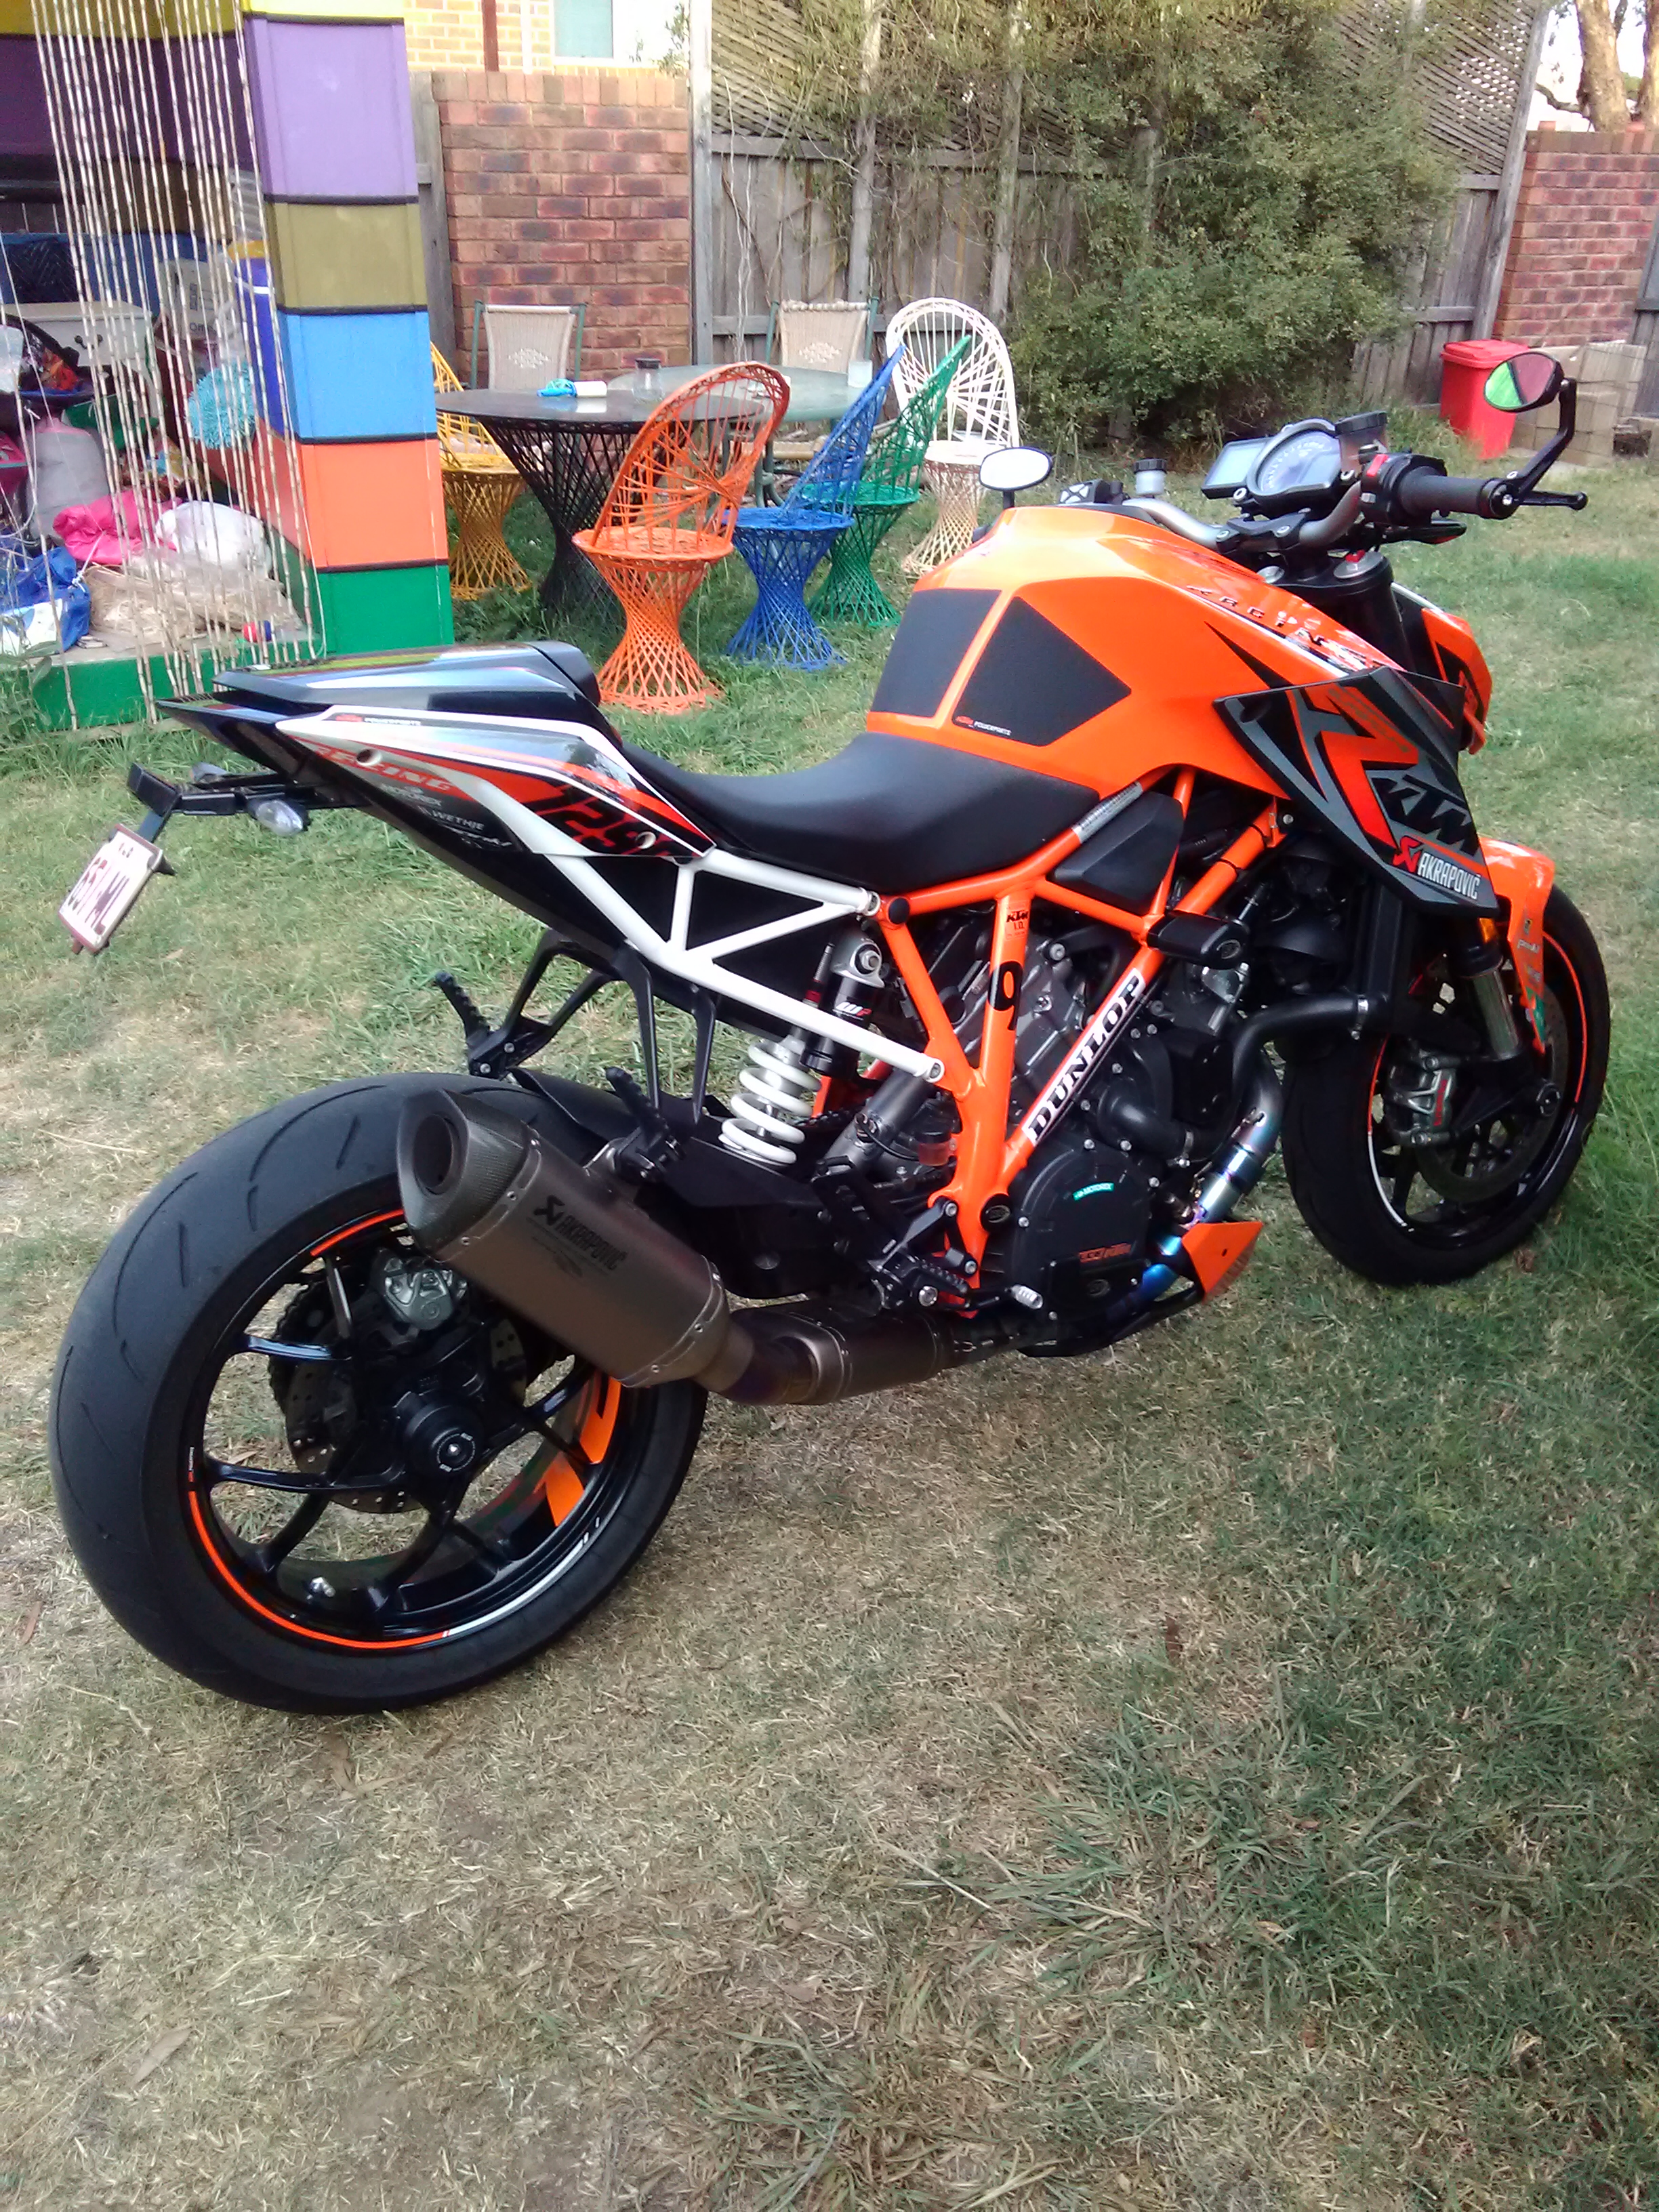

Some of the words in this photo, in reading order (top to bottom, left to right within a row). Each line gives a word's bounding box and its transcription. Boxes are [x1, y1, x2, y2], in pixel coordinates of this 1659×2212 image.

[1370, 774, 1480, 857] KTM
[835, 1002, 872, 1017] WP
[1028, 975, 1140, 1141] DUNLOP
